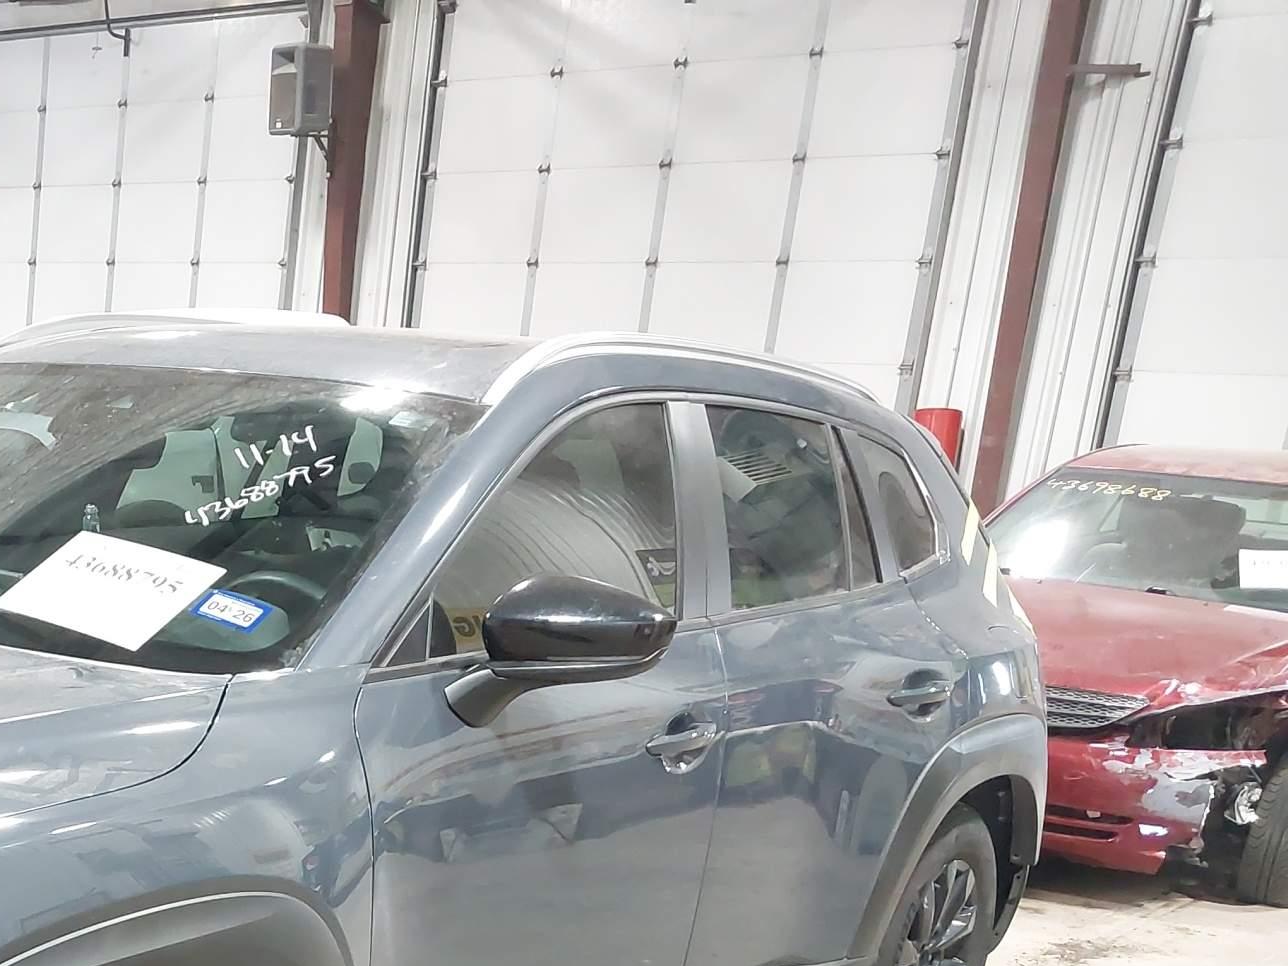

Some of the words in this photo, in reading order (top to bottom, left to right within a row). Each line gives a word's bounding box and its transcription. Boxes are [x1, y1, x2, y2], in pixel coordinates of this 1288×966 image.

[234, 425, 317, 469] 11-14
[207, 600, 228, 613] 04
[232, 609, 255, 623] 26
